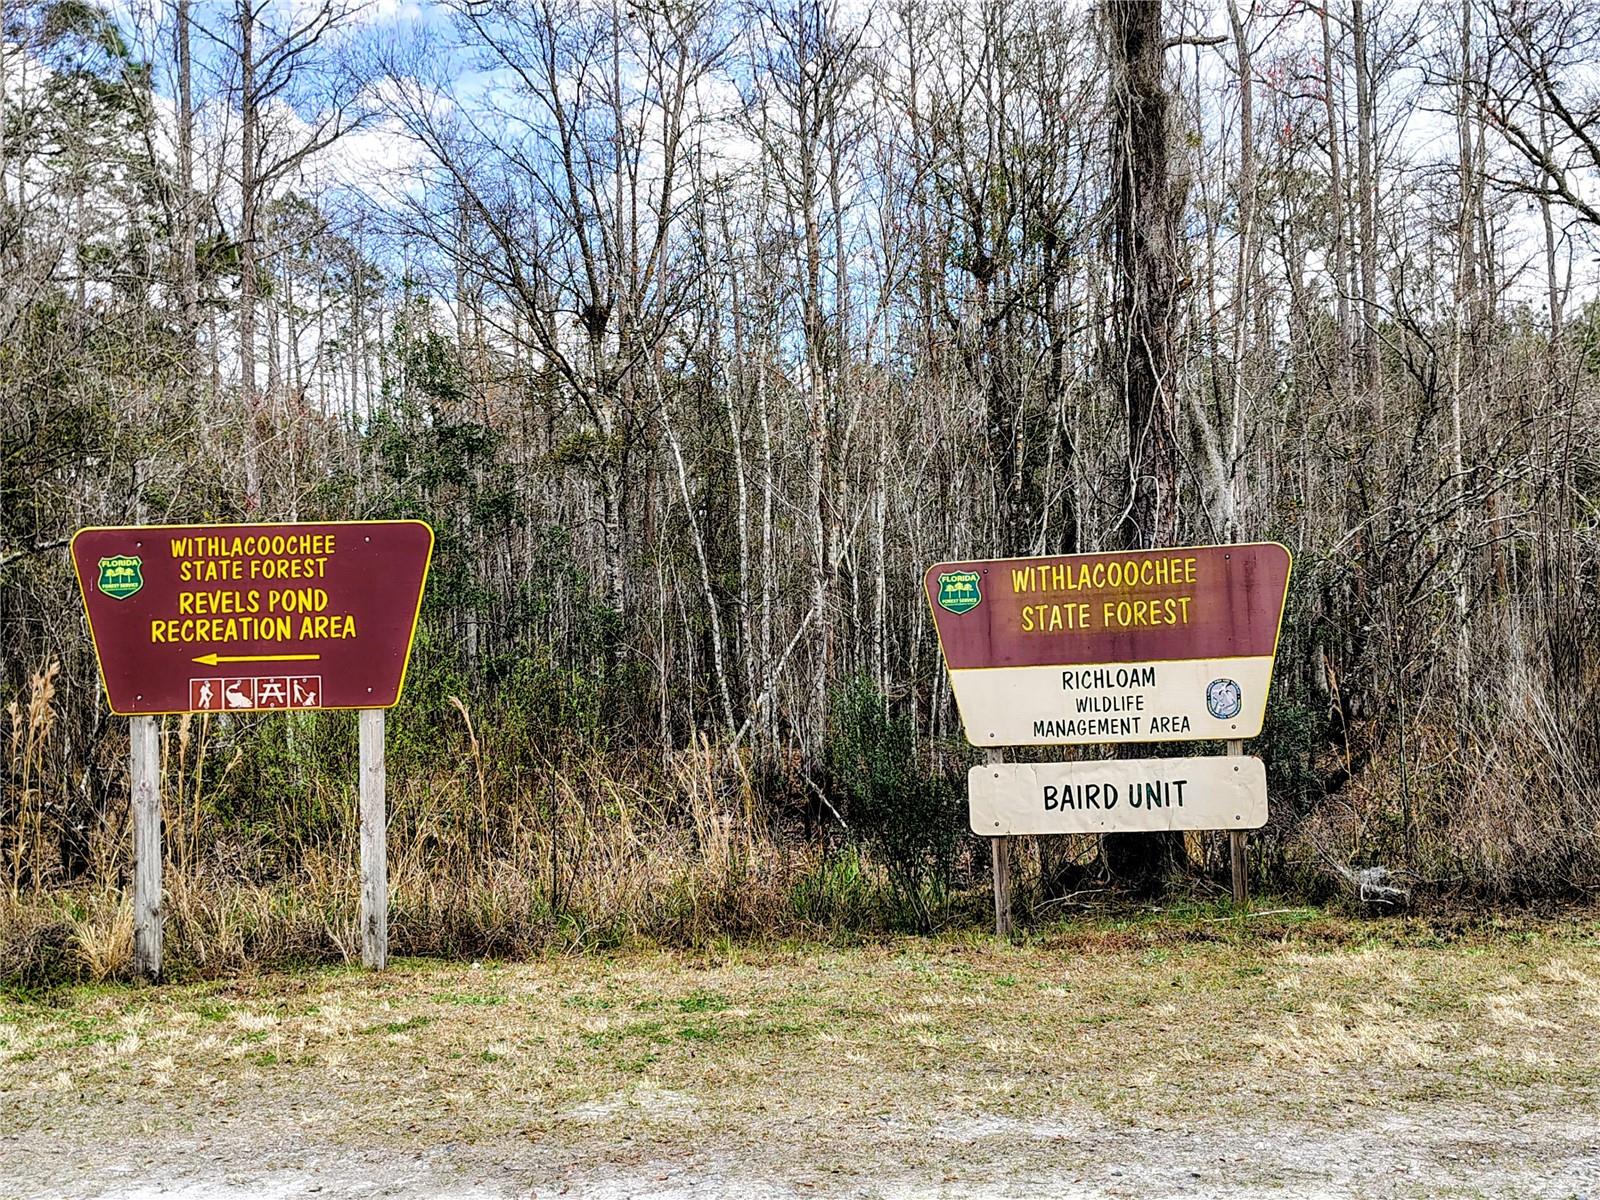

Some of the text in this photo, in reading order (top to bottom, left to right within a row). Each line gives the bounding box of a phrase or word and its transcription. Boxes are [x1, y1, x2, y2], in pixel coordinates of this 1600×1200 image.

[171, 535, 336, 558] WITHLACOOCHEE
[101, 559, 138, 567] FLORIDA
[179, 557, 328, 582] STATE FOREST
[941, 574, 976, 583] FLORIDA
[1011, 558, 1197, 593] WITHLACOOCHEE
[179, 588, 329, 615] REVELS POND
[1021, 597, 1192, 632] STATE FOREST
[151, 615, 357, 643] RECREATION AREA
[1062, 667, 1156, 690] RICHLOAM
[1075, 695, 1144, 714] WILDLIFE
[1033, 716, 1191, 738] MANAGEMENT AREA
[1043, 780, 1188, 812] BAIRD UNIT
